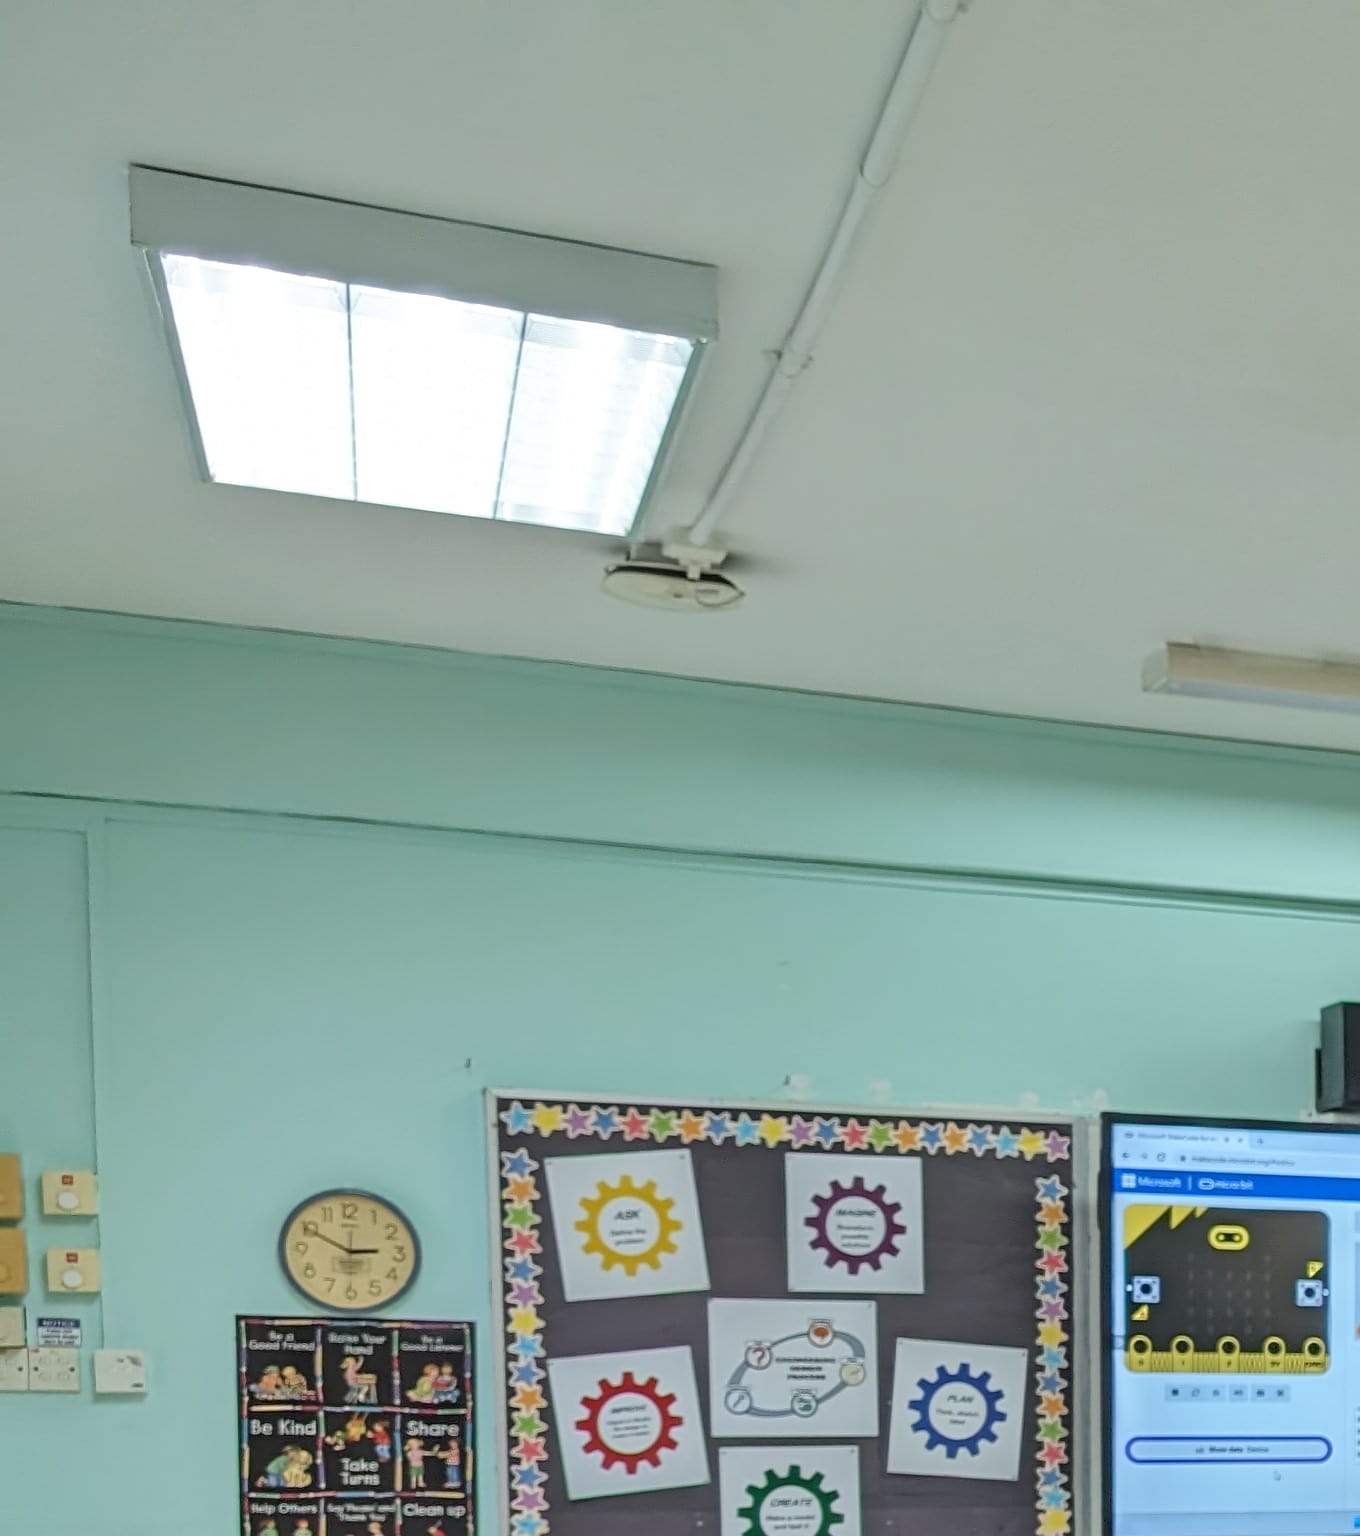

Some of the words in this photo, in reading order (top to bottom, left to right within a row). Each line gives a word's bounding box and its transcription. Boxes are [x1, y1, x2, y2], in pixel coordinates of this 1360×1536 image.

[341, 1202, 359, 1220] 12
[384, 1222, 399, 1240] 2
[392, 1245, 406, 1263] 3
[303, 1262, 317, 1280] 8
[385, 1266, 398, 1281] 4
[323, 1276, 337, 1294] 7
[345, 1284, 358, 1300] 6
[368, 1280, 382, 1297] 5
[251, 1420, 274, 1436] Be
[278, 1419, 317, 1437] Kind
[407, 1420, 460, 1437] Share
[340, 1457, 379, 1473] Take
[340, 1471, 381, 1487] Turns
[251, 1504, 276, 1516] Help
[278, 1503, 318, 1515] Others
[403, 1503, 444, 1517] Clean
[447, 1505, 466, 1518] up
